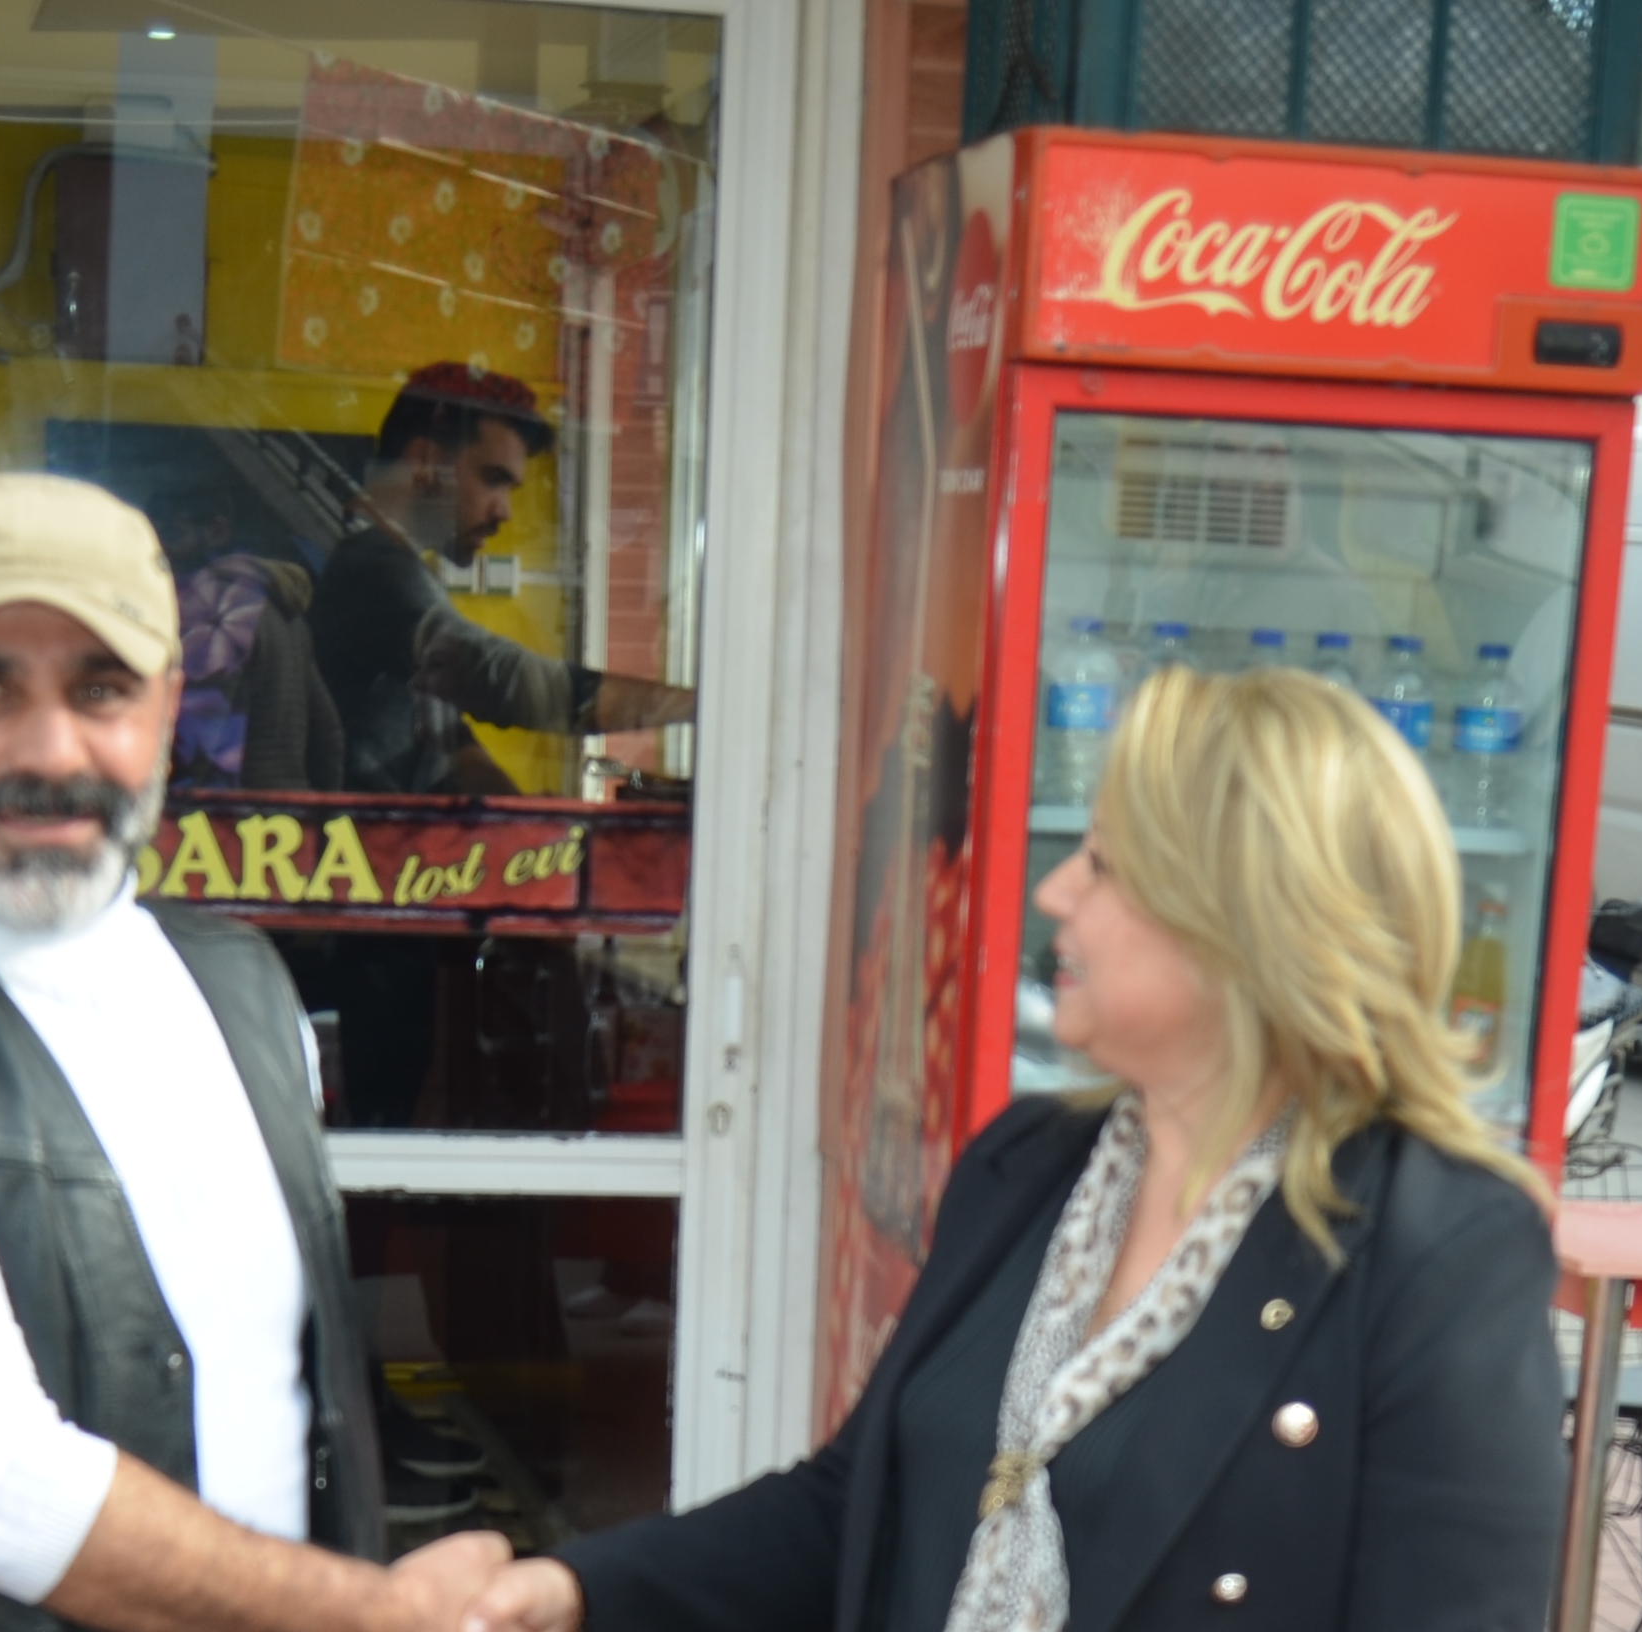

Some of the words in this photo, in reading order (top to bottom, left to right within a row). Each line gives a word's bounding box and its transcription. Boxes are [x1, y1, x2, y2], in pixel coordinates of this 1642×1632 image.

[1101, 188, 1459, 327] Coca-Cola
[393, 843, 486, 906] tost
[504, 826, 584, 885] evi
